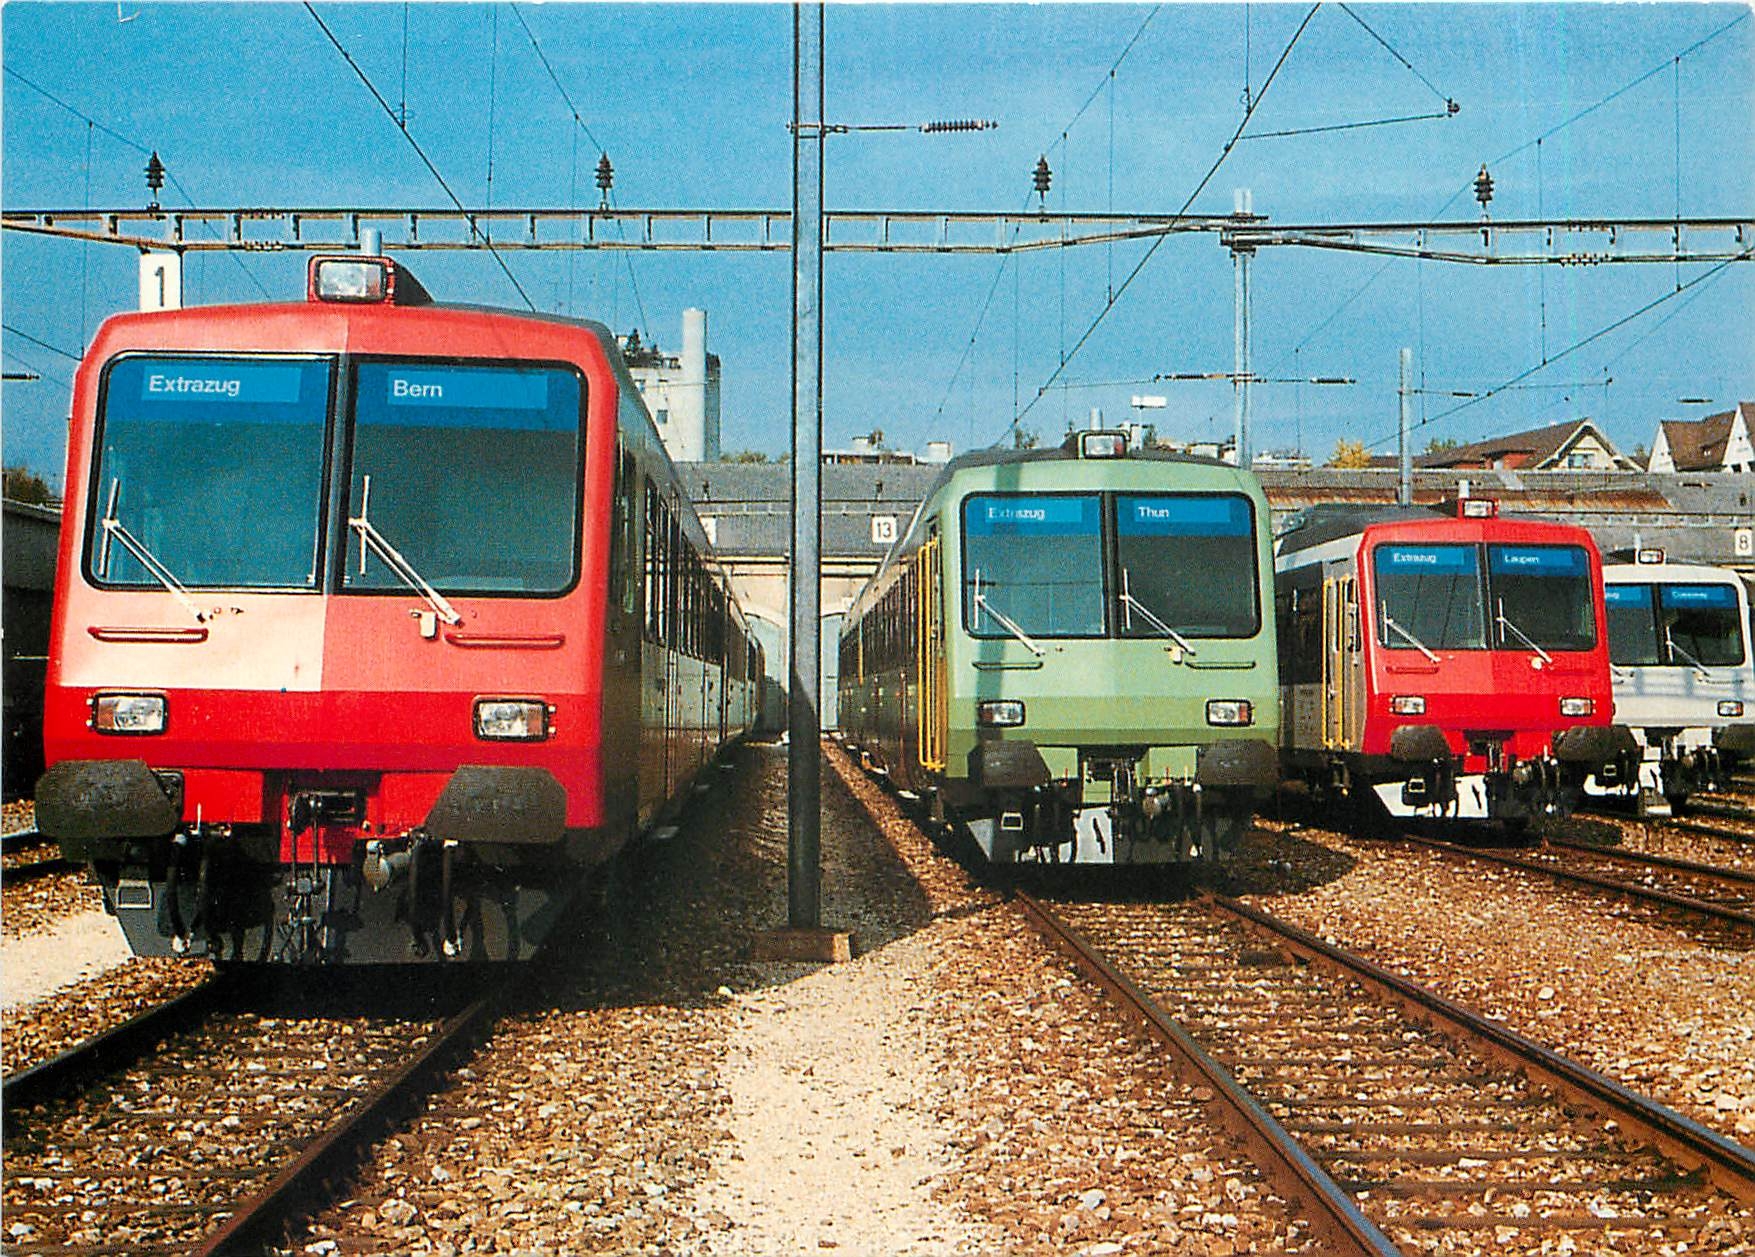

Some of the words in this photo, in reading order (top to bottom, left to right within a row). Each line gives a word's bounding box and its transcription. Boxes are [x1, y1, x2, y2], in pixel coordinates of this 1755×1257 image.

[153, 266, 165, 307] 1
[148, 375, 241, 397] Extrazug
[393, 380, 443, 398] Bern
[988, 507, 1045, 521] Extrazug
[1138, 506, 1169, 518] Thun
[876, 522, 892, 539] 13
[1738, 534, 1749, 551] 8
